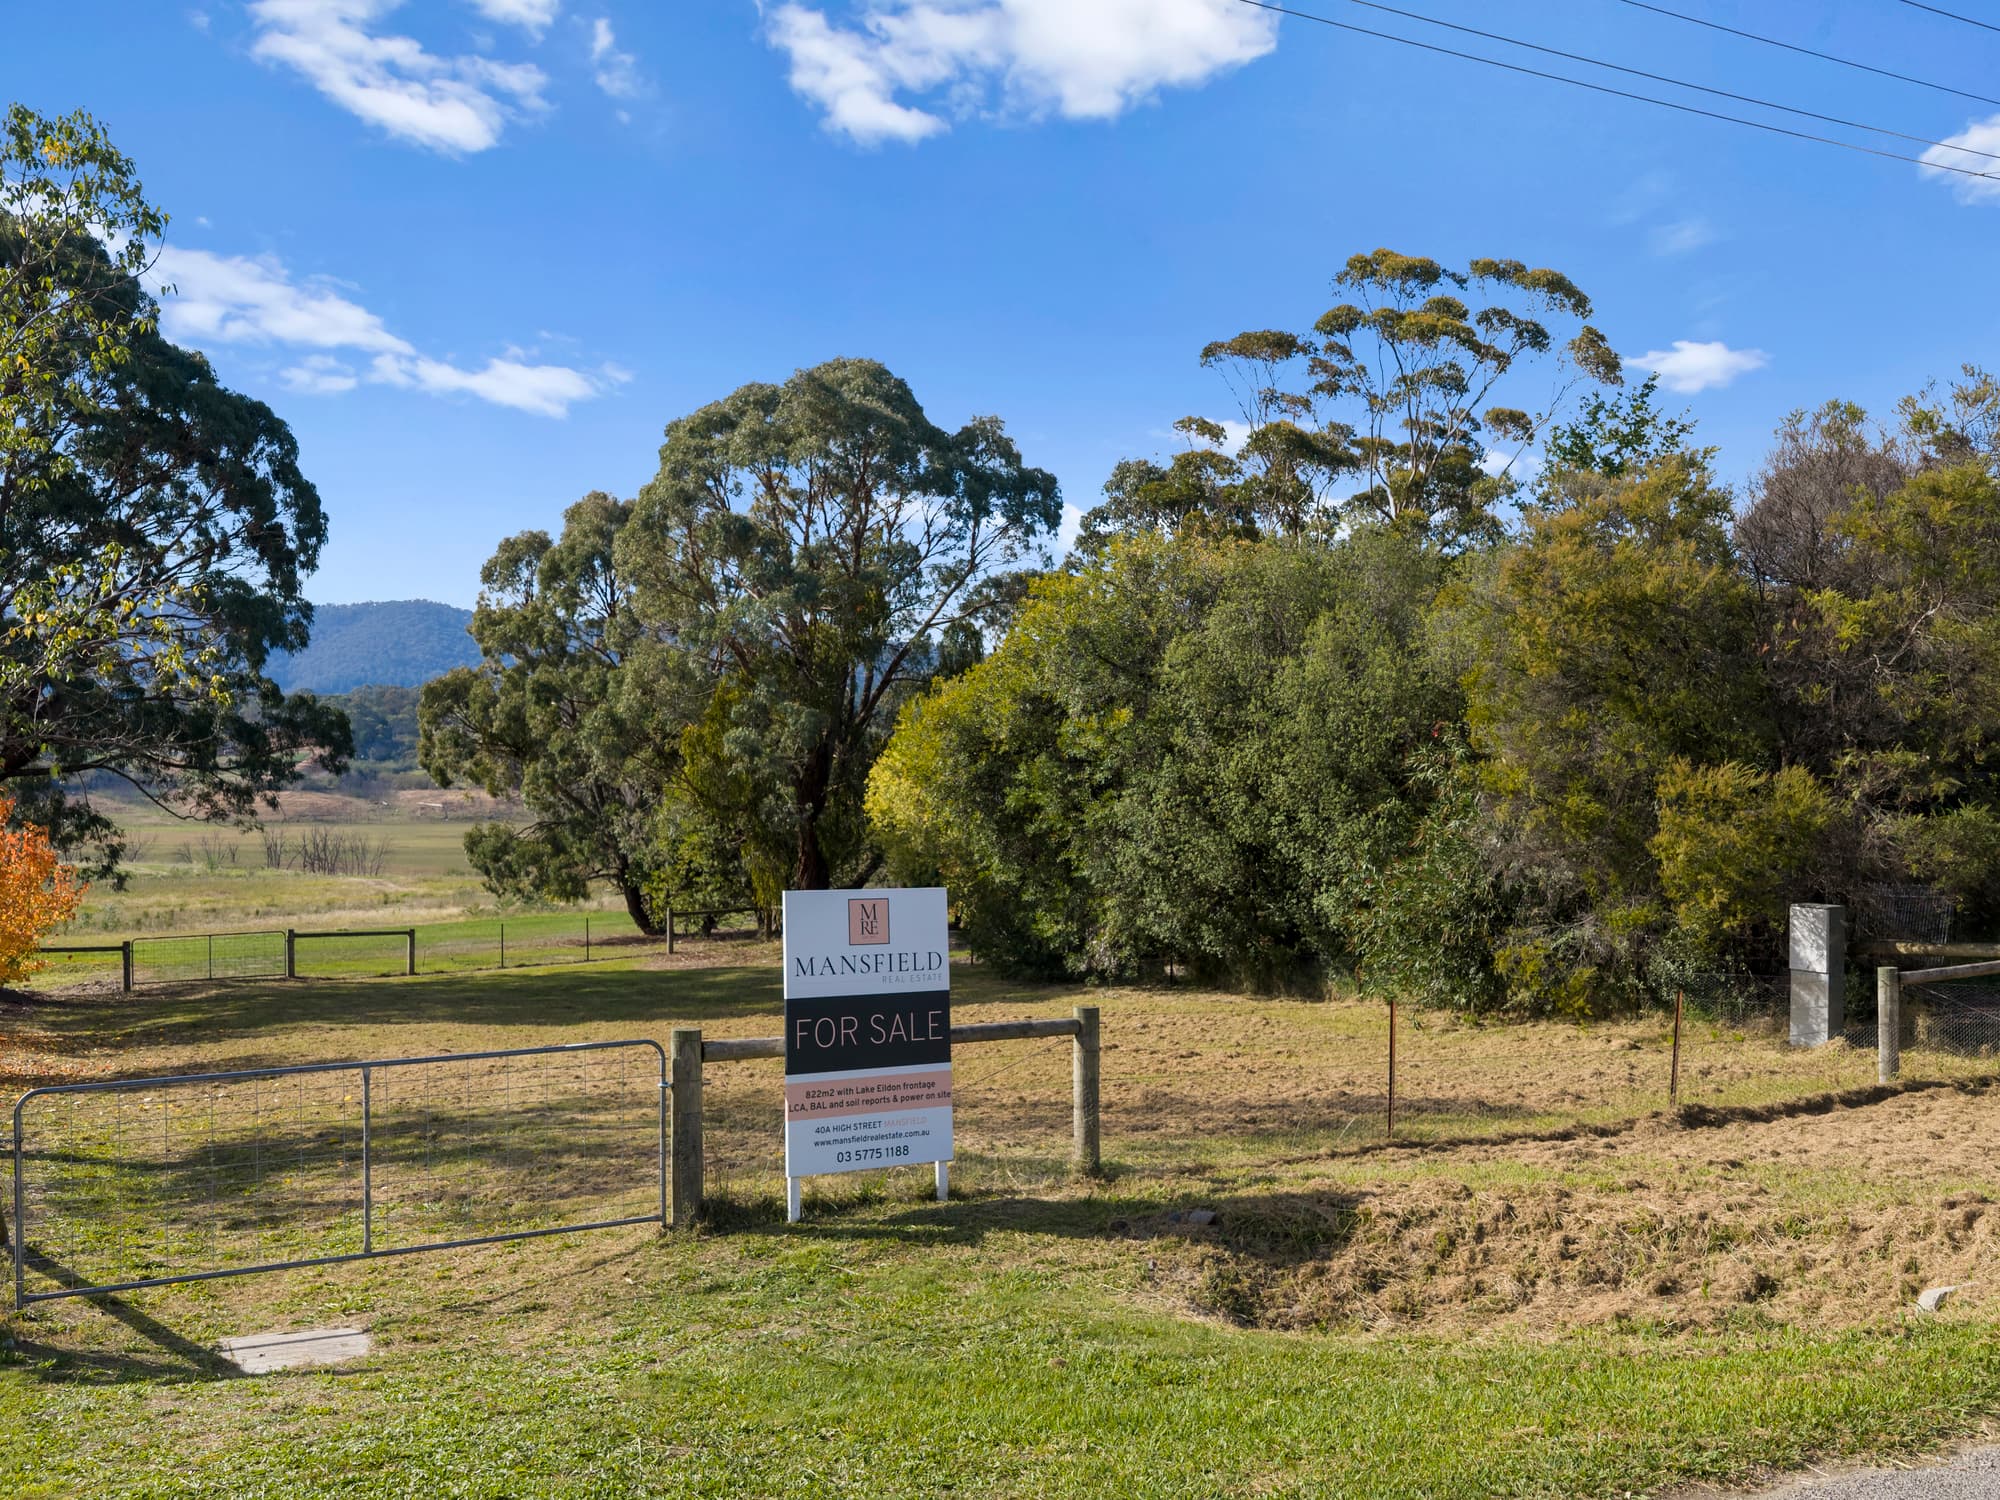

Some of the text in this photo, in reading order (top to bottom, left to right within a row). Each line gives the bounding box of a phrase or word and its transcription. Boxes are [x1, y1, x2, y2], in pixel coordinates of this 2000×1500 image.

[795, 952, 942, 977] MANSFIELD
[882, 973, 942, 984] REAL ESTATE
[796, 1010, 944, 1050] FOR SALE
[805, 1080, 936, 1099] 822m2 with Lake Eildon frontage
[788, 1090, 951, 1113] LCA, BAL and soil reports & power on site
[815, 1116, 928, 1134] 40A HIGH STREET MANSFIELD
[814, 1130, 930, 1147] www.mansfieldrealestate.com.au
[836, 1145, 910, 1163] 03 5775 1188
